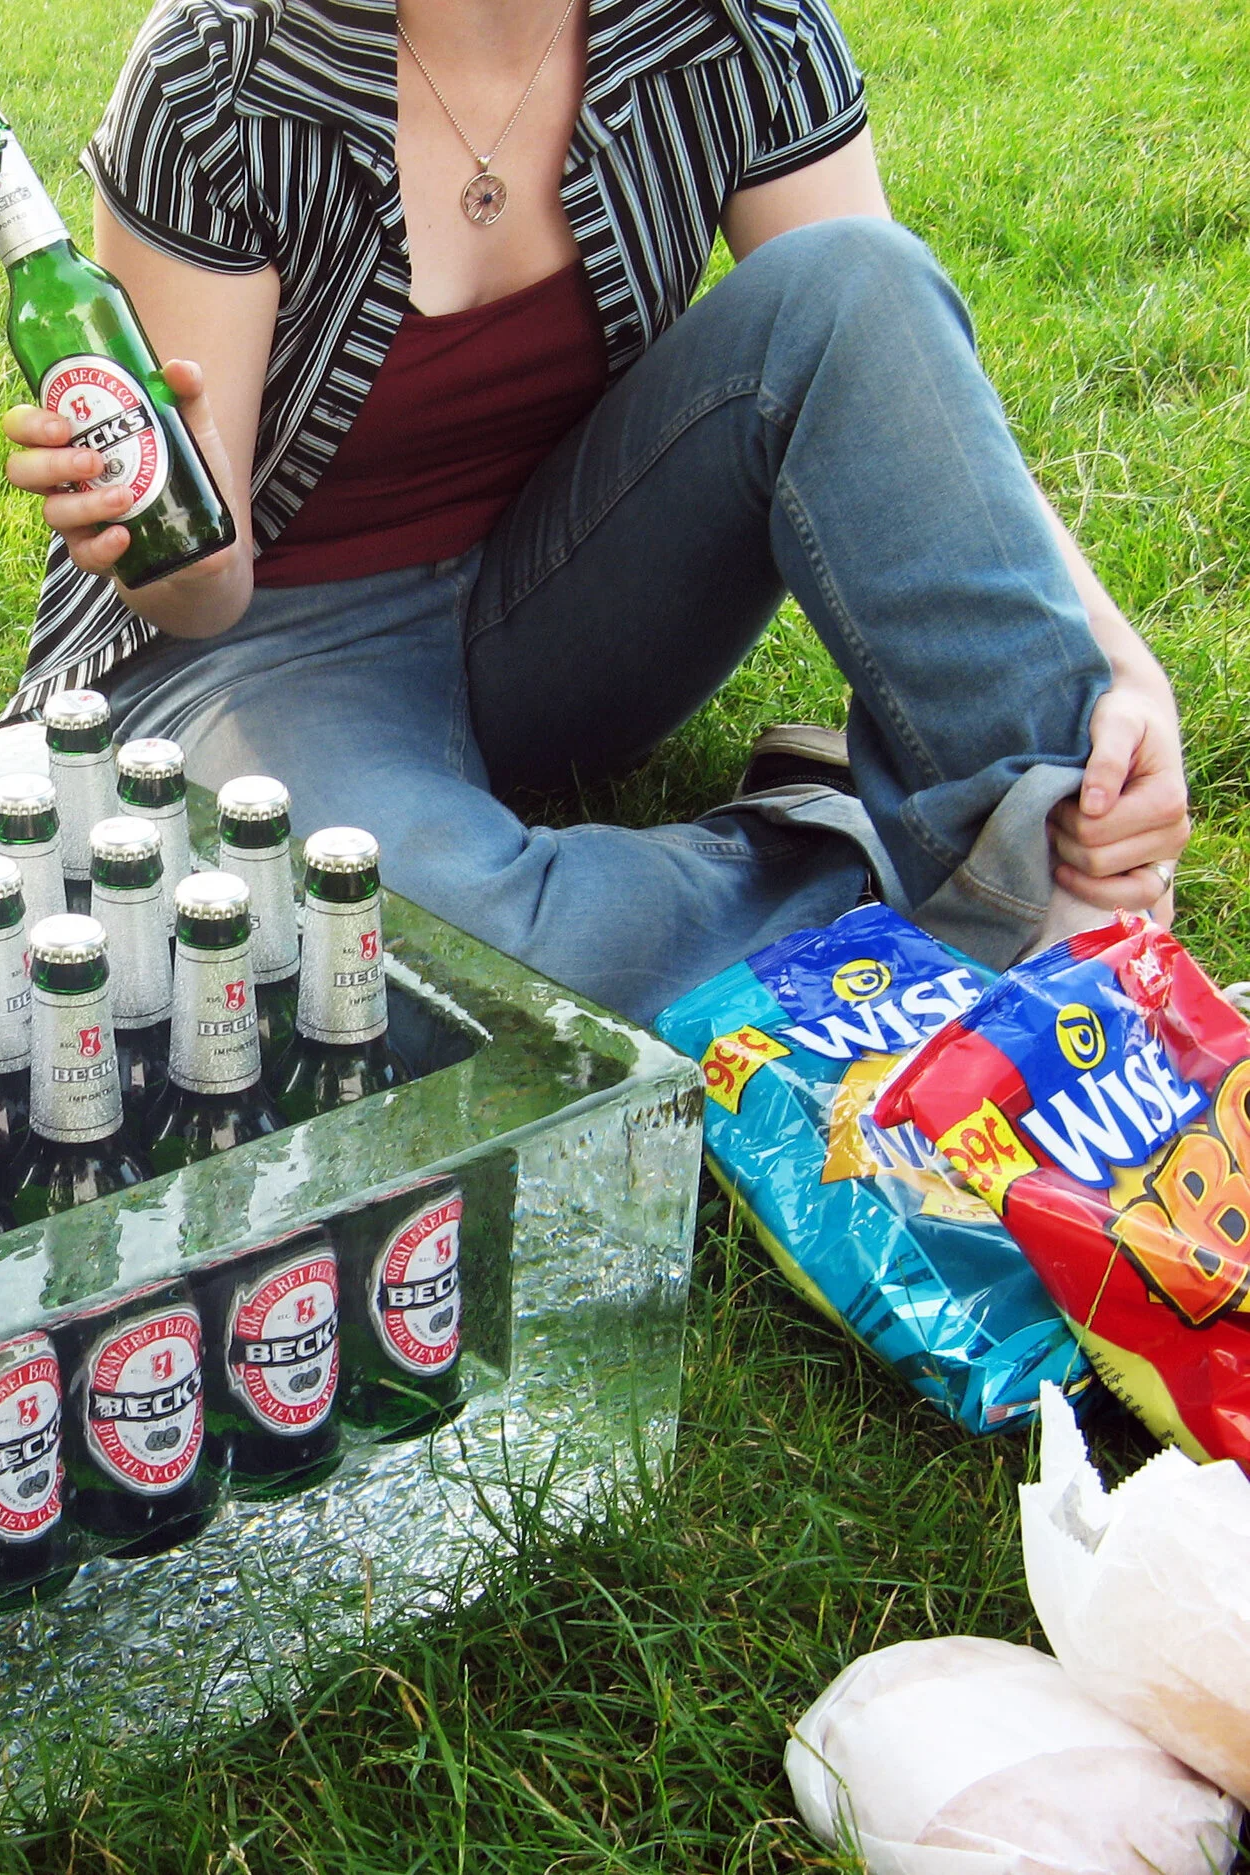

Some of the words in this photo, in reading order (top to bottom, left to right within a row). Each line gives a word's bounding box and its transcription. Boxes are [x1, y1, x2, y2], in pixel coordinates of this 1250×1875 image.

[69, 369, 106, 387] BECK
[107, 379, 118, 392] &
[131, 433, 153, 498] ERMANY
[1020, 1039, 1201, 1182] WISE
